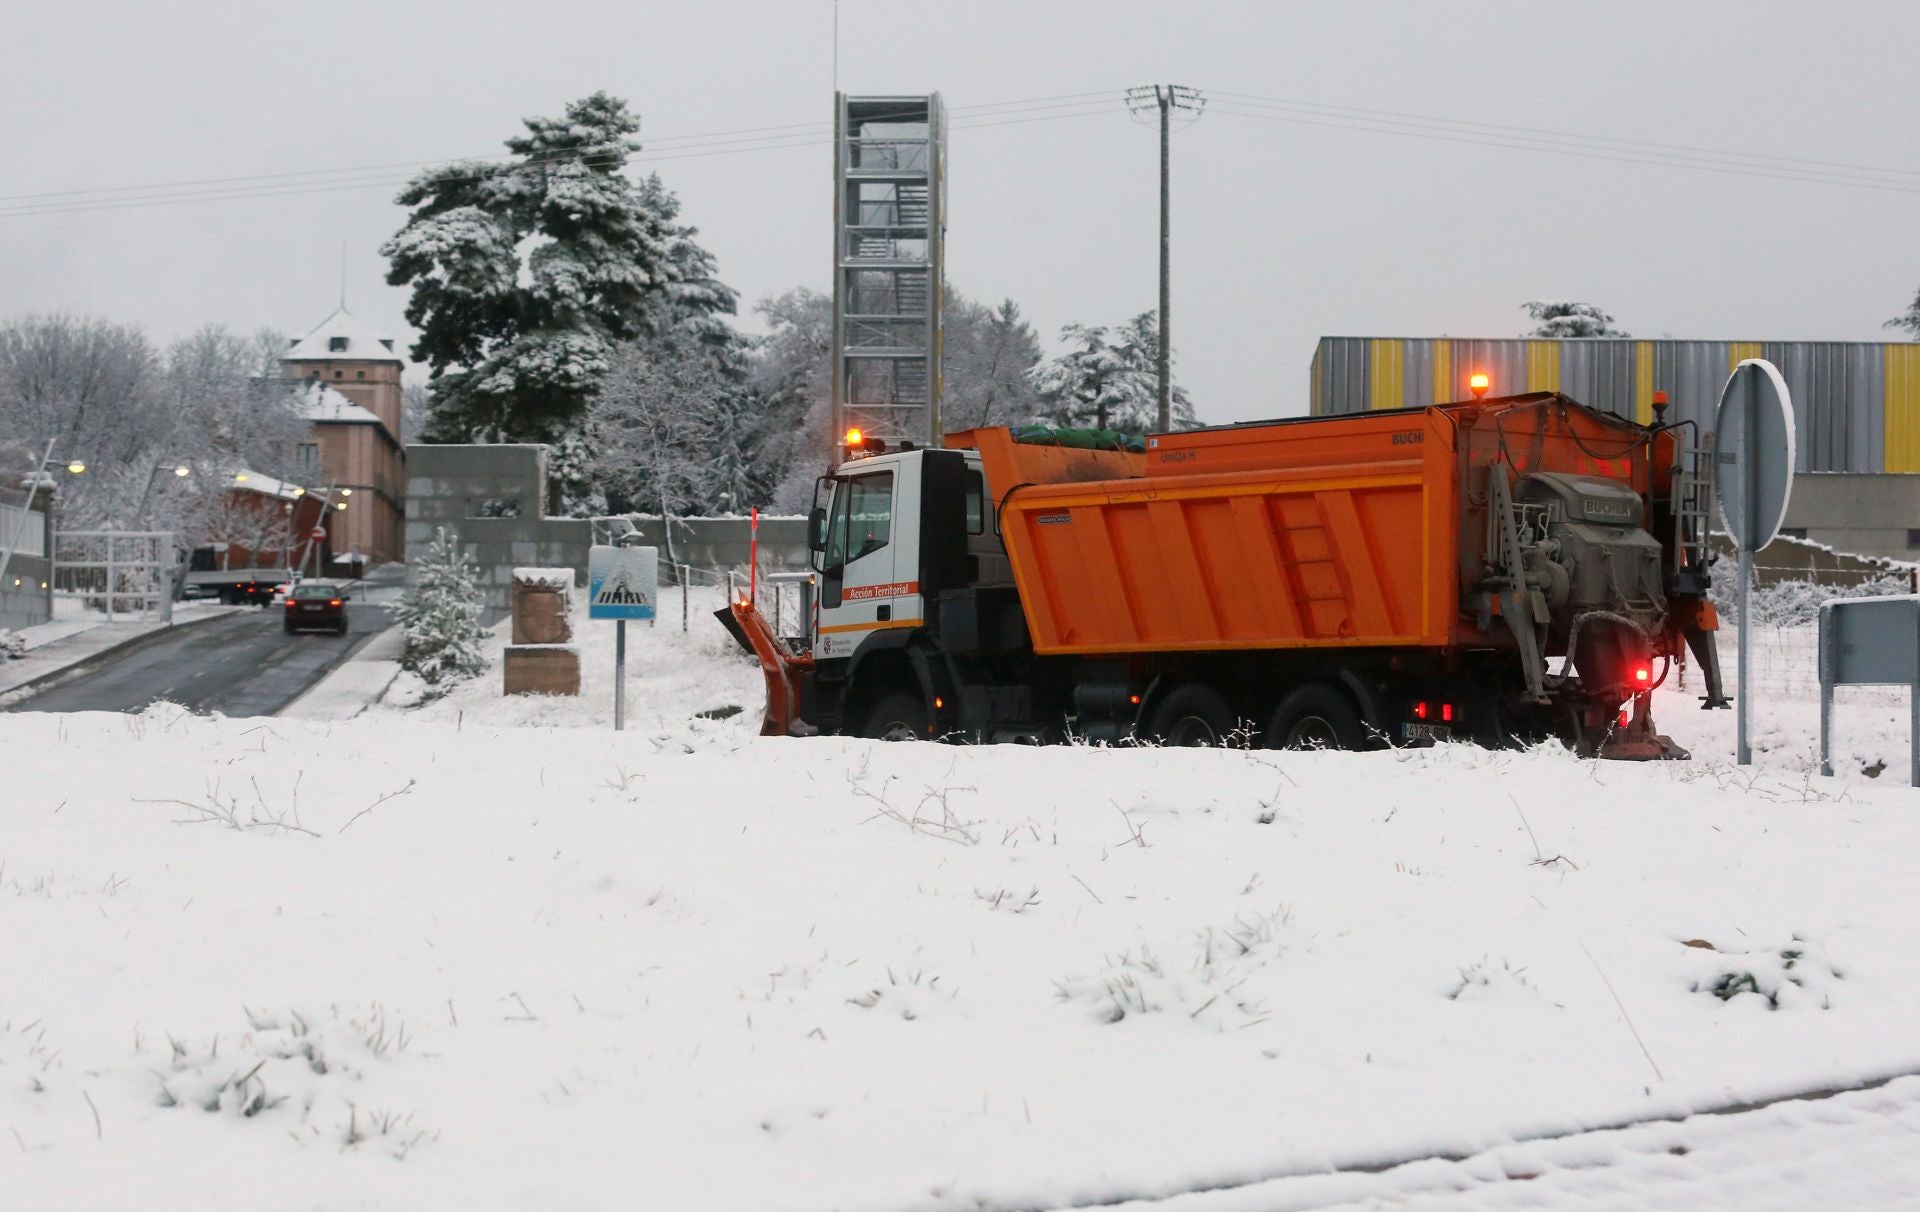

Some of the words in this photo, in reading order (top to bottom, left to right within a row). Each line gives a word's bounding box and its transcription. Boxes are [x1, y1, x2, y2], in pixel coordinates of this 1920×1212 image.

[1585, 500, 1630, 517] BUCHER
[850, 586, 873, 599] Acción
[874, 583, 909, 597] Territorial
